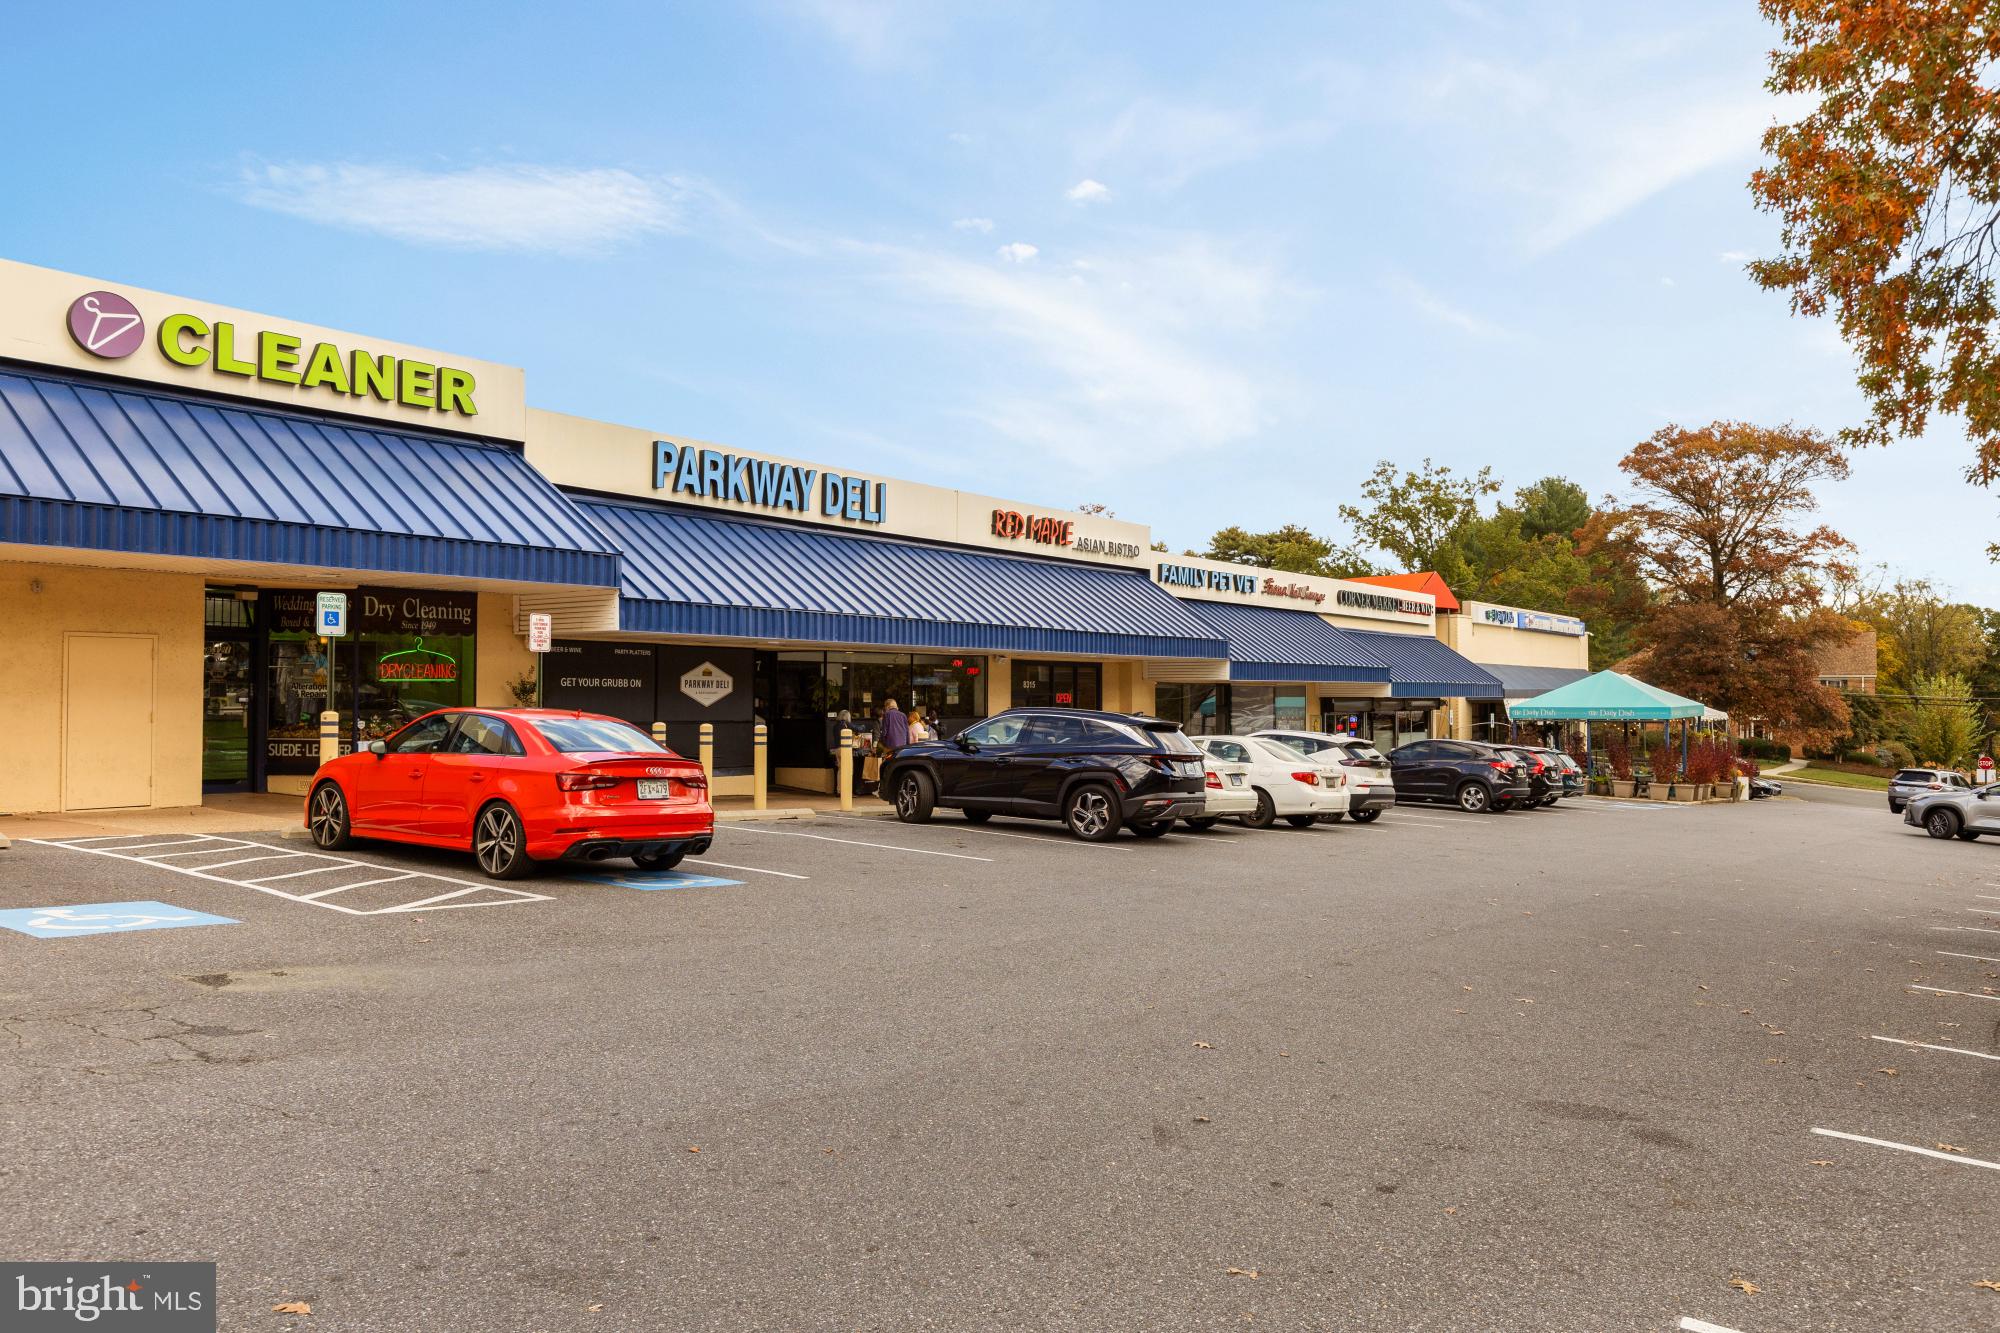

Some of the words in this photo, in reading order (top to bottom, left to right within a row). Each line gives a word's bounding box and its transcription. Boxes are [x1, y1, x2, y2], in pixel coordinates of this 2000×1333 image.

[157, 314, 478, 415] CLEANER
[652, 440, 817, 512] PARKWAY
[821, 472, 886, 523] DELI
[991, 509, 1025, 539] RED
[1026, 514, 1074, 546] MAPLE
[1076, 536, 1105, 553] ASIAN
[1108, 541, 1140, 558] BISTRO
[1158, 563, 1208, 588] FAMILY
[1208, 570, 1234, 592] PET
[1235, 574, 1258, 594] VET
[274, 595, 315, 614] Wedding
[320, 595, 344, 603] RESERVED
[1337, 590, 1371, 609] CORNER
[364, 596, 395, 621] Dry
[403, 597, 471, 624] Cleaning
[402, 620, 418, 629] Since
[560, 677, 577, 687] GET
[578, 678, 600, 687] YOUR
[601, 678, 628, 688] GRUBB
[630, 679, 642, 688] ON
[684, 679, 714, 689] PARKWAY
[715, 680, 730, 689] DELI
[1023, 680, 1036, 689] 8315
[301, 690, 327, 700] Repairs
[1055, 693, 1072, 703] OPEN
[1540, 708, 1556, 716] Dish
